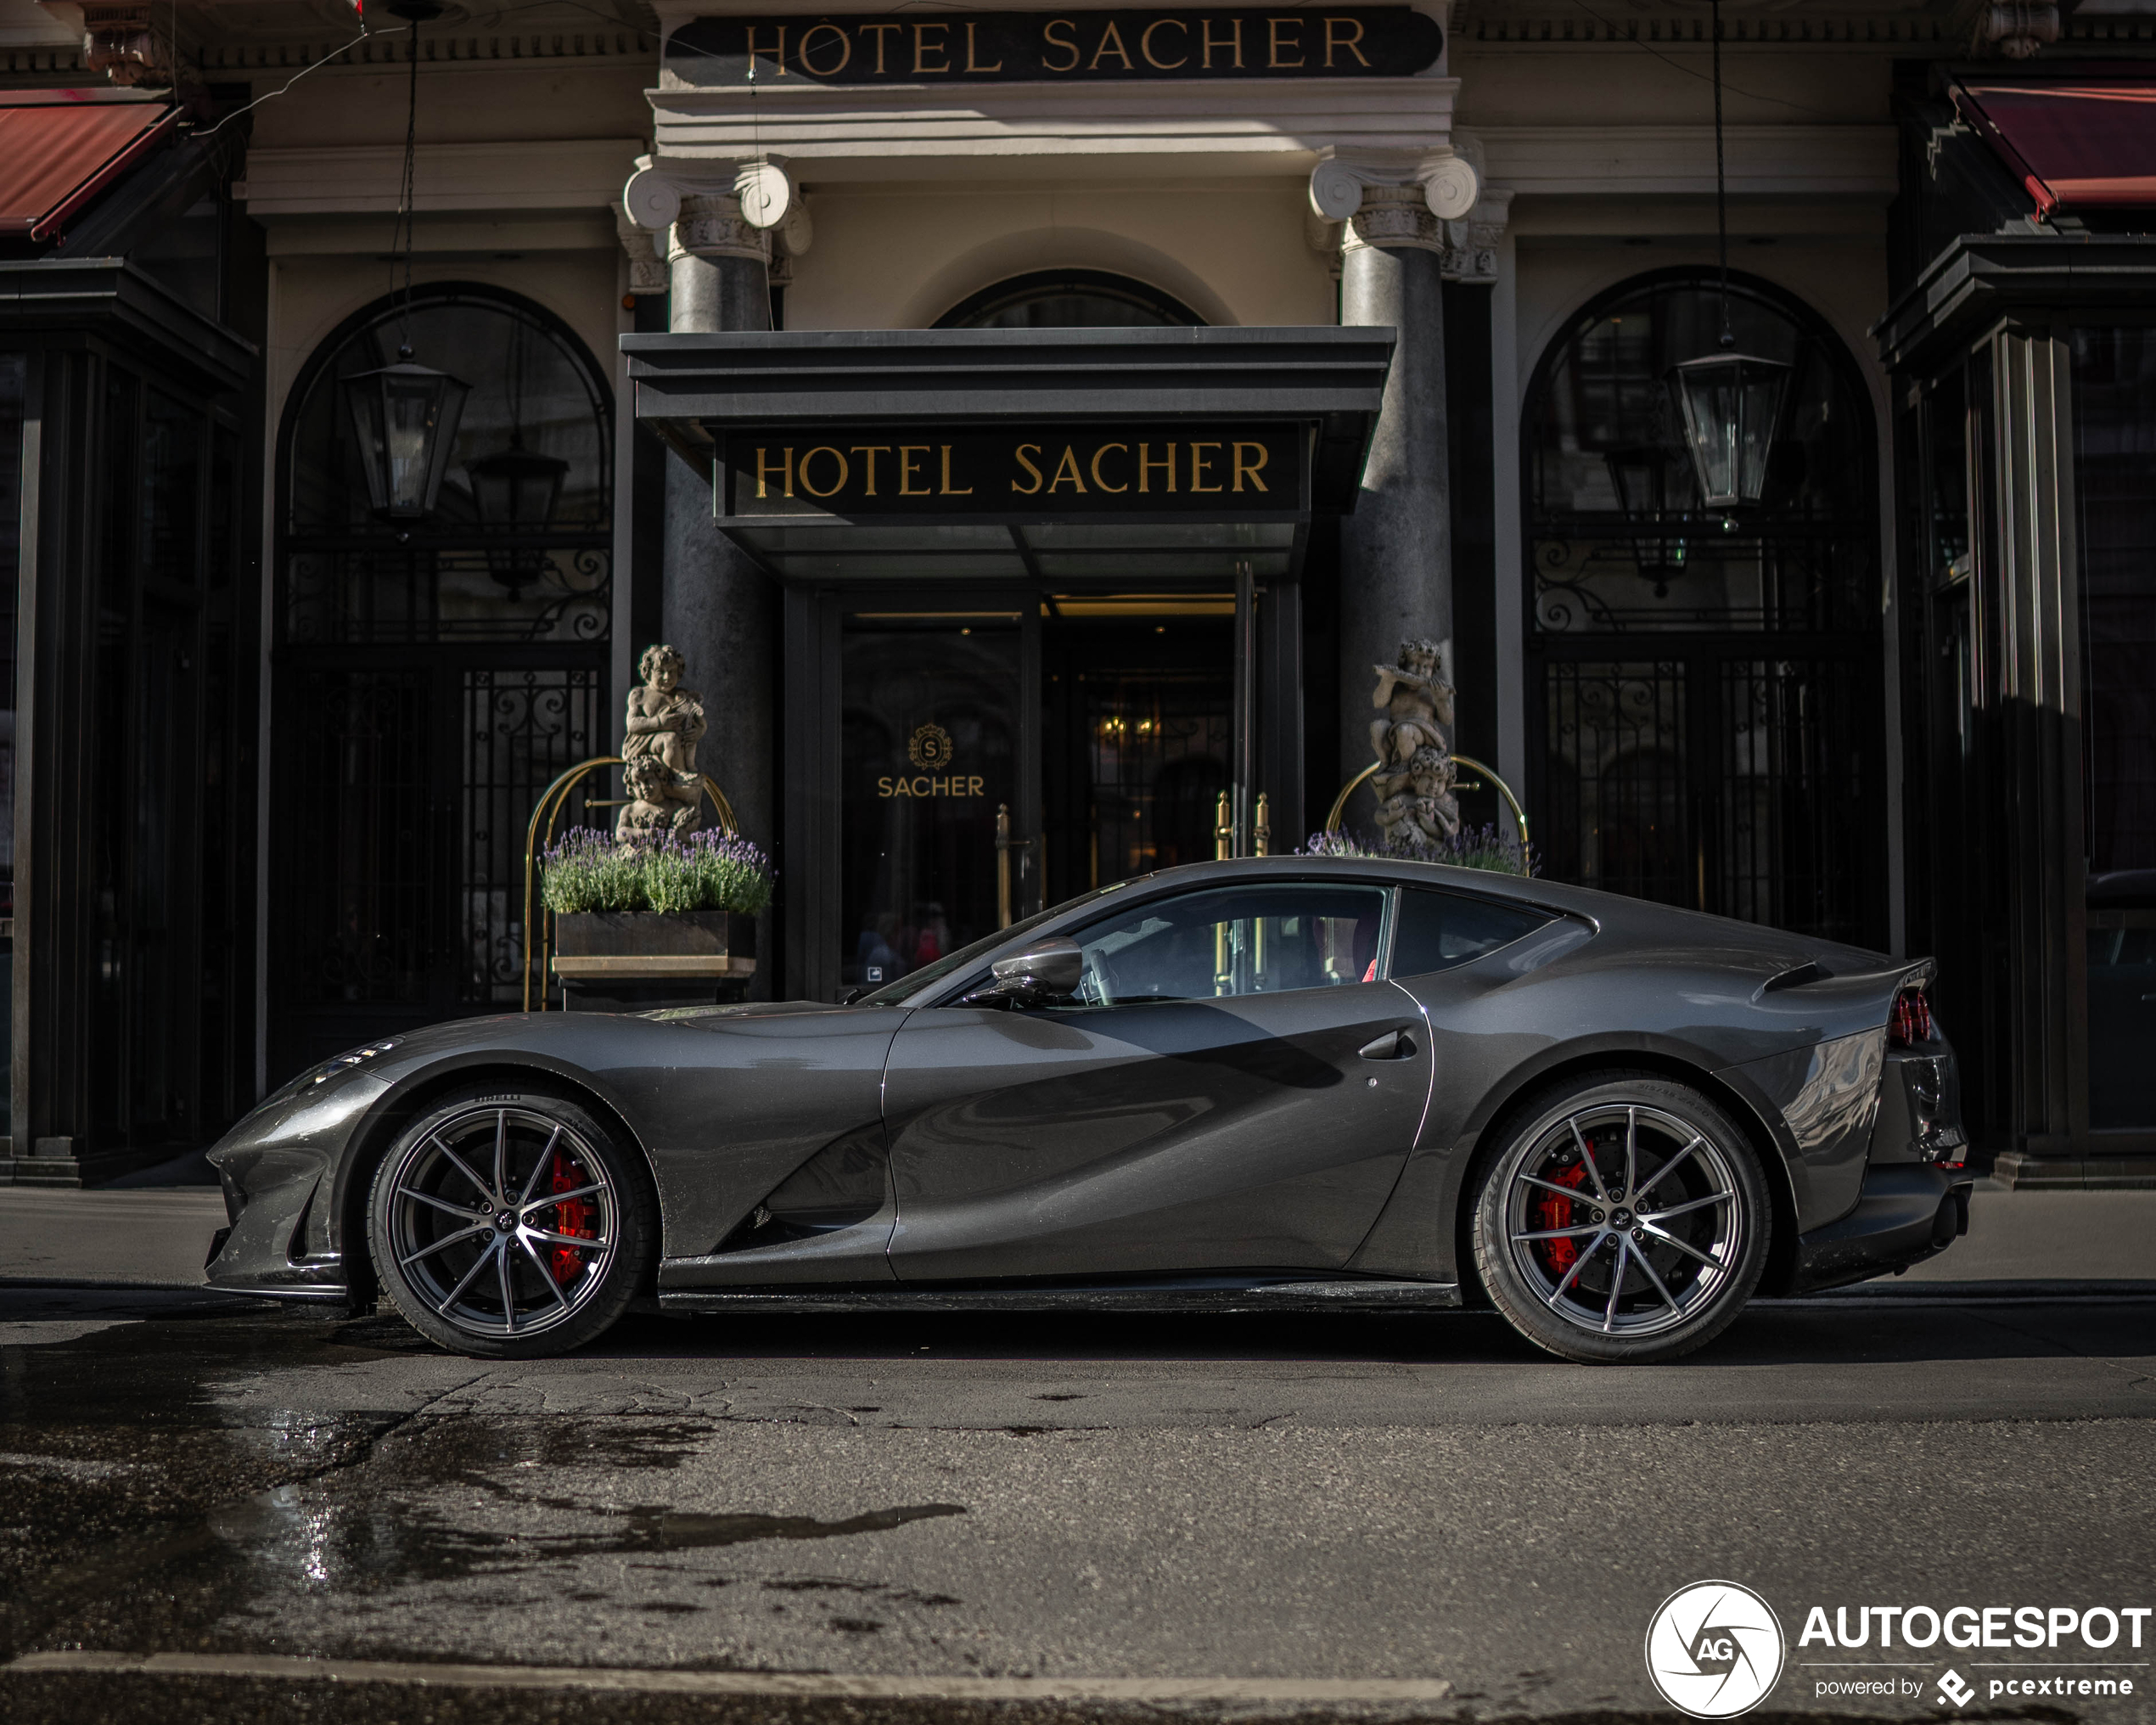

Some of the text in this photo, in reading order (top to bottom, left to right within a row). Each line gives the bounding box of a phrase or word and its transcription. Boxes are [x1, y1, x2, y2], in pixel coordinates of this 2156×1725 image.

[745, 18, 1373, 76] HÔTEL SACHER
[755, 442, 1270, 498] HOTEL SACHER
[924, 741, 937, 756] S
[878, 776, 985, 797] SACHER
[1485, 1169, 1502, 1247] ZERO
